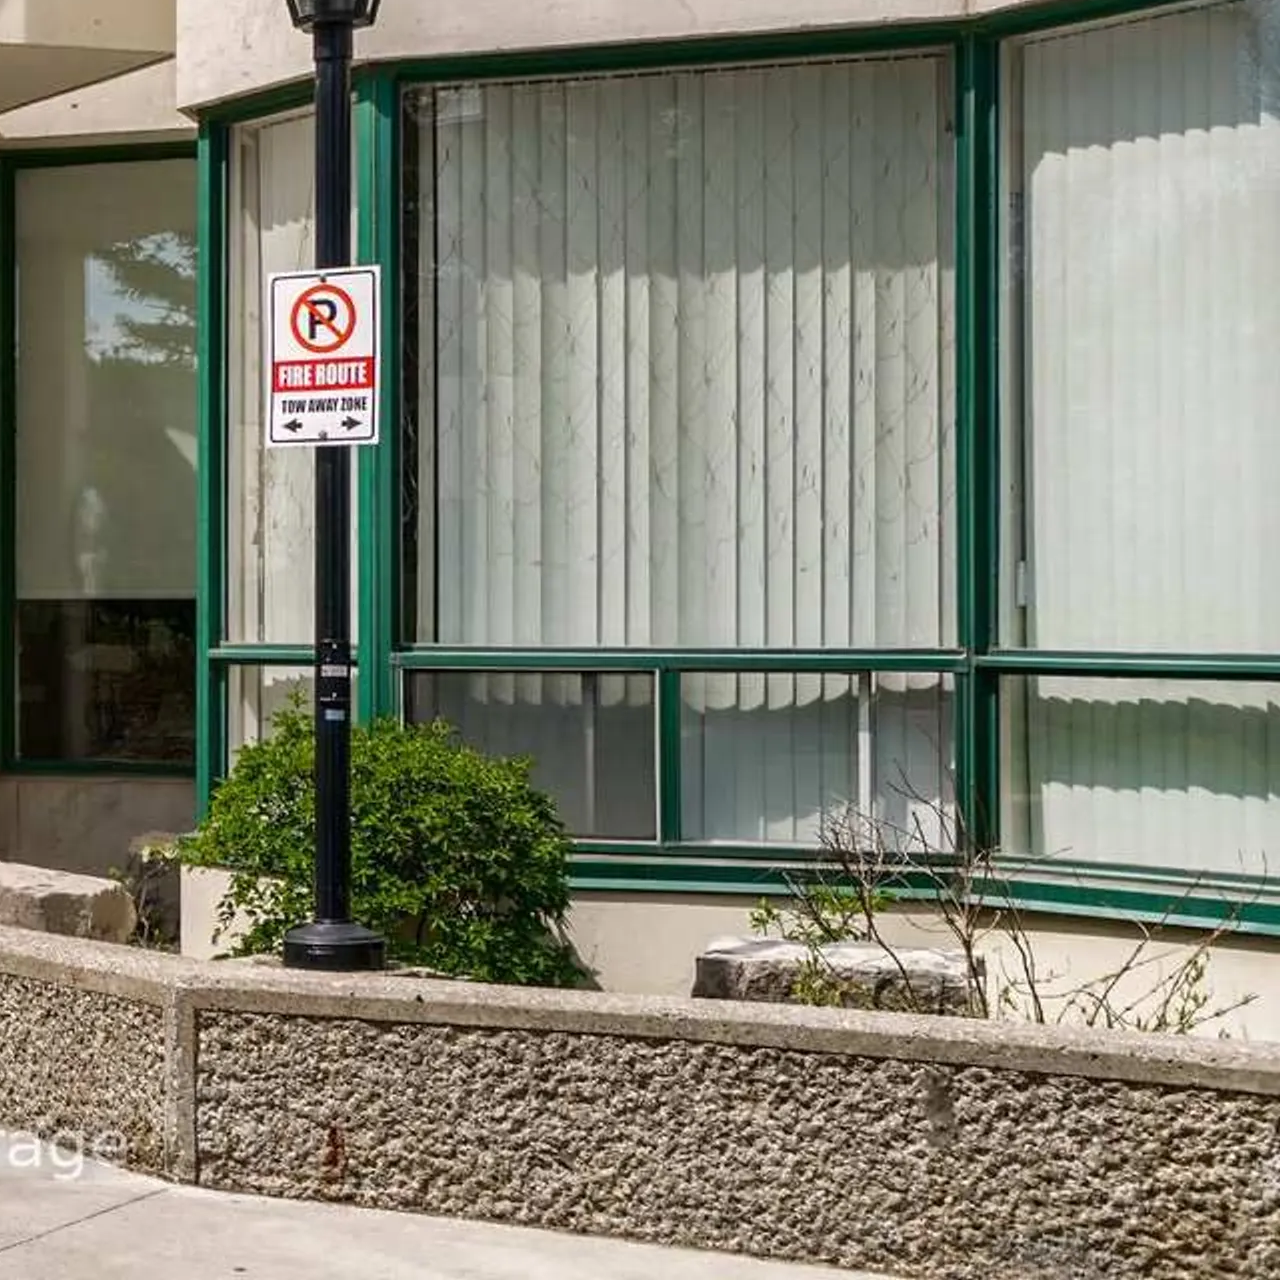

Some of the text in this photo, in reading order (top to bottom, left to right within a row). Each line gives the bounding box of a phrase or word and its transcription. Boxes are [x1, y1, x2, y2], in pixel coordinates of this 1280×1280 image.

[278, 361, 367, 388] FIRE ROUTE
[281, 396, 368, 415] TOW AWAY ZONE
